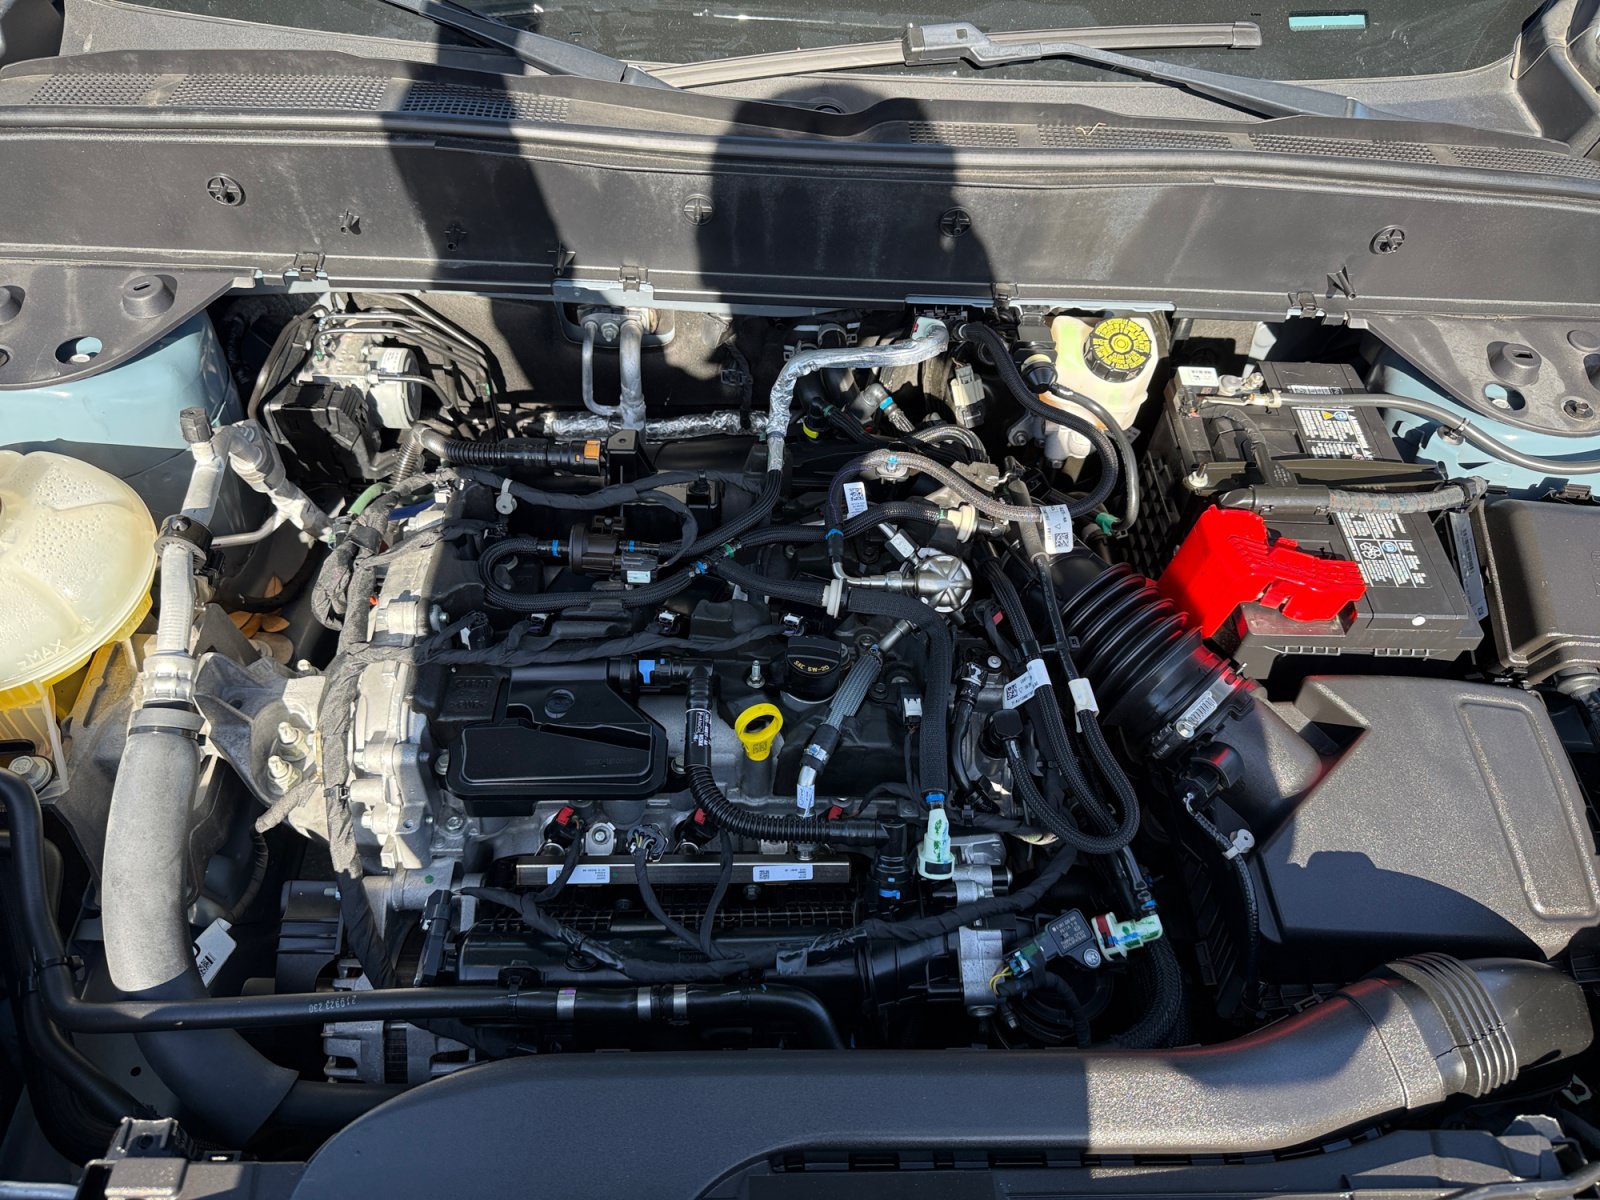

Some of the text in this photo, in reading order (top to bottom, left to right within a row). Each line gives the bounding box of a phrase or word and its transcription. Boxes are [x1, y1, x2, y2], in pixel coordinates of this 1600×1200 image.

[24, 639, 70, 665] MAX
[793, 660, 830, 672] SAE 5W-20
